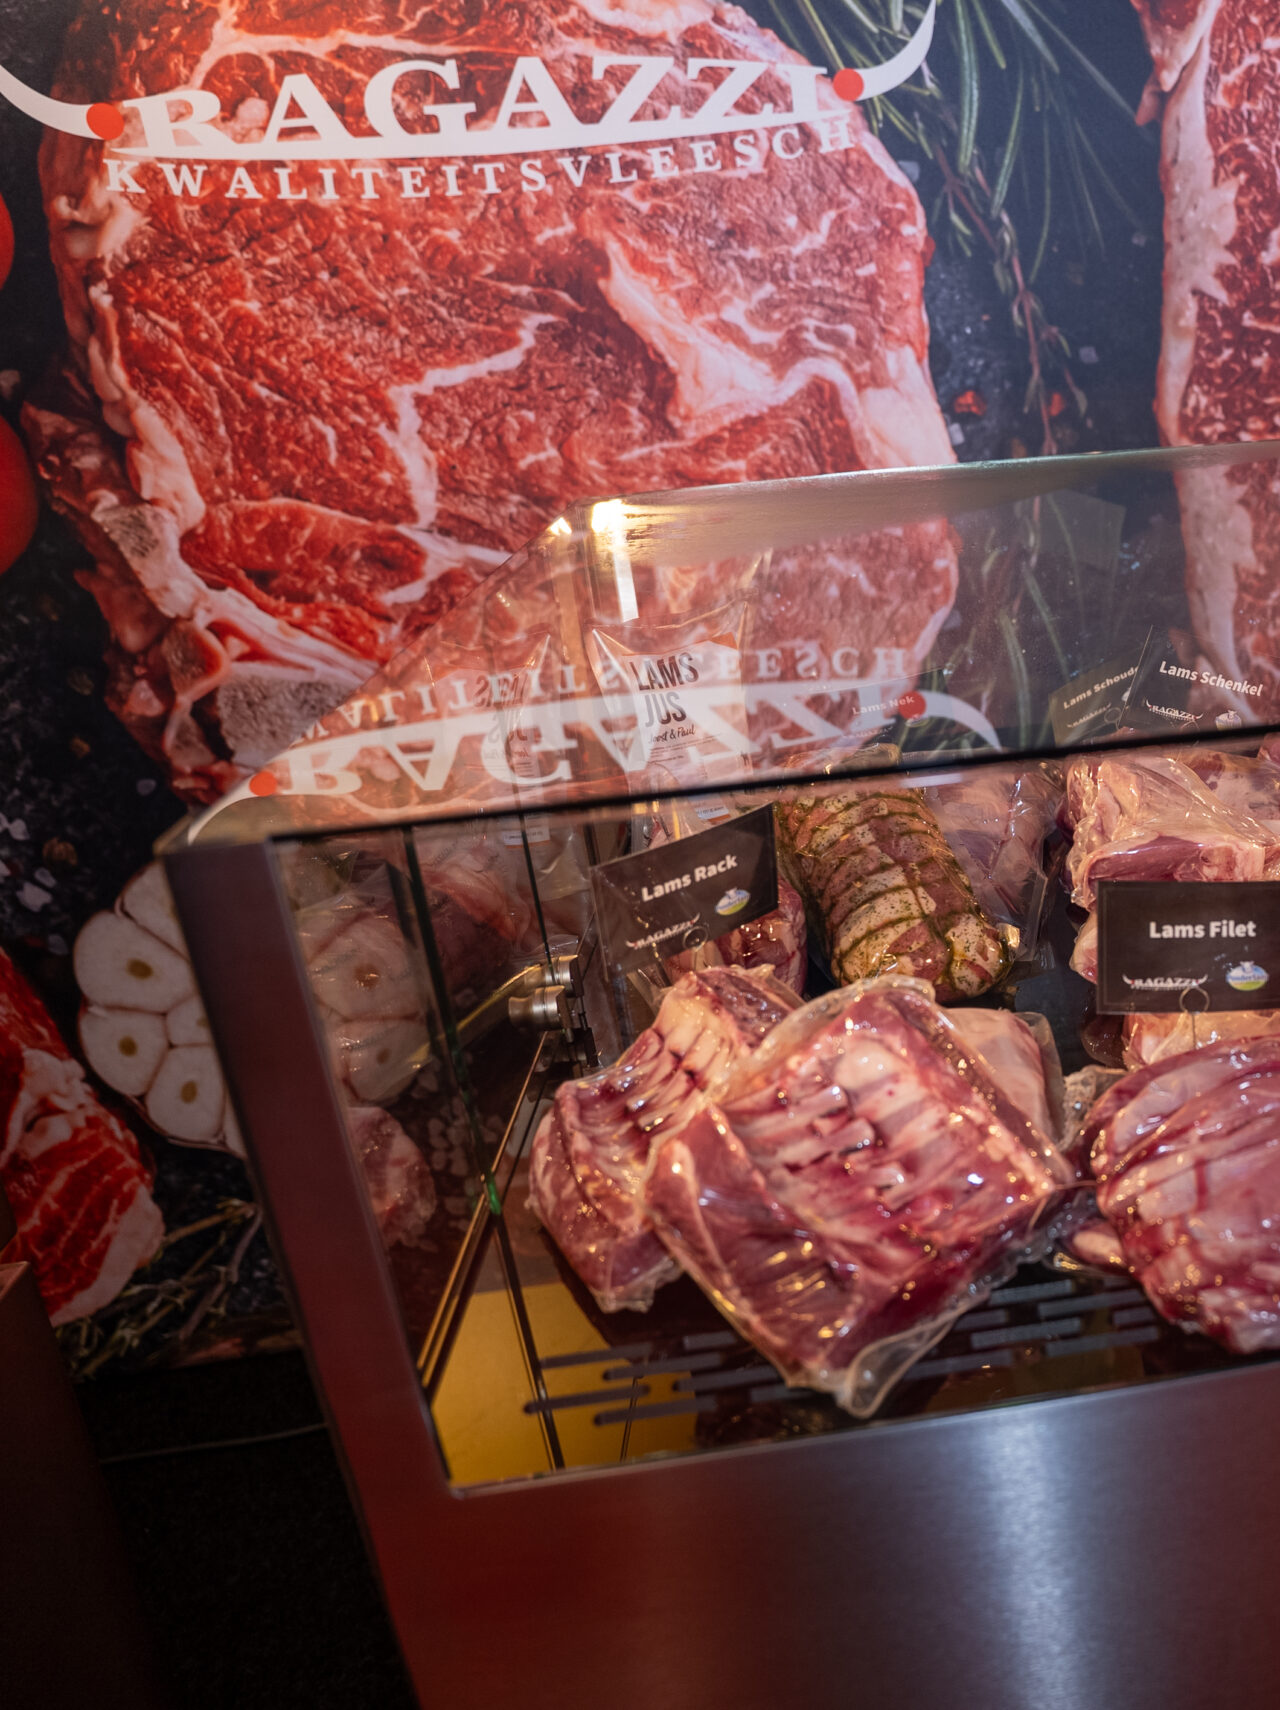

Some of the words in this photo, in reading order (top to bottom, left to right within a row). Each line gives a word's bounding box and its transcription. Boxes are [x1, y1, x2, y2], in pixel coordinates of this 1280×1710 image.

[121, 55, 831, 156] RAGAZZI
[103, 119, 856, 200] KWALITEITSVLEESCH
[629, 652, 699, 691] LAMS
[1159, 660, 1199, 681] Lams
[1199, 672, 1264, 697] Schenkel
[645, 691, 687, 727] JUS
[852, 703, 887, 715] Lams
[890, 695, 915, 708] Nek
[1063, 688, 1093, 710] Lams
[641, 874, 692, 902] Lams
[694, 854, 738, 882] Rack
[1149, 921, 1205, 938] Lams
[1209, 920, 1257, 938] Filet
